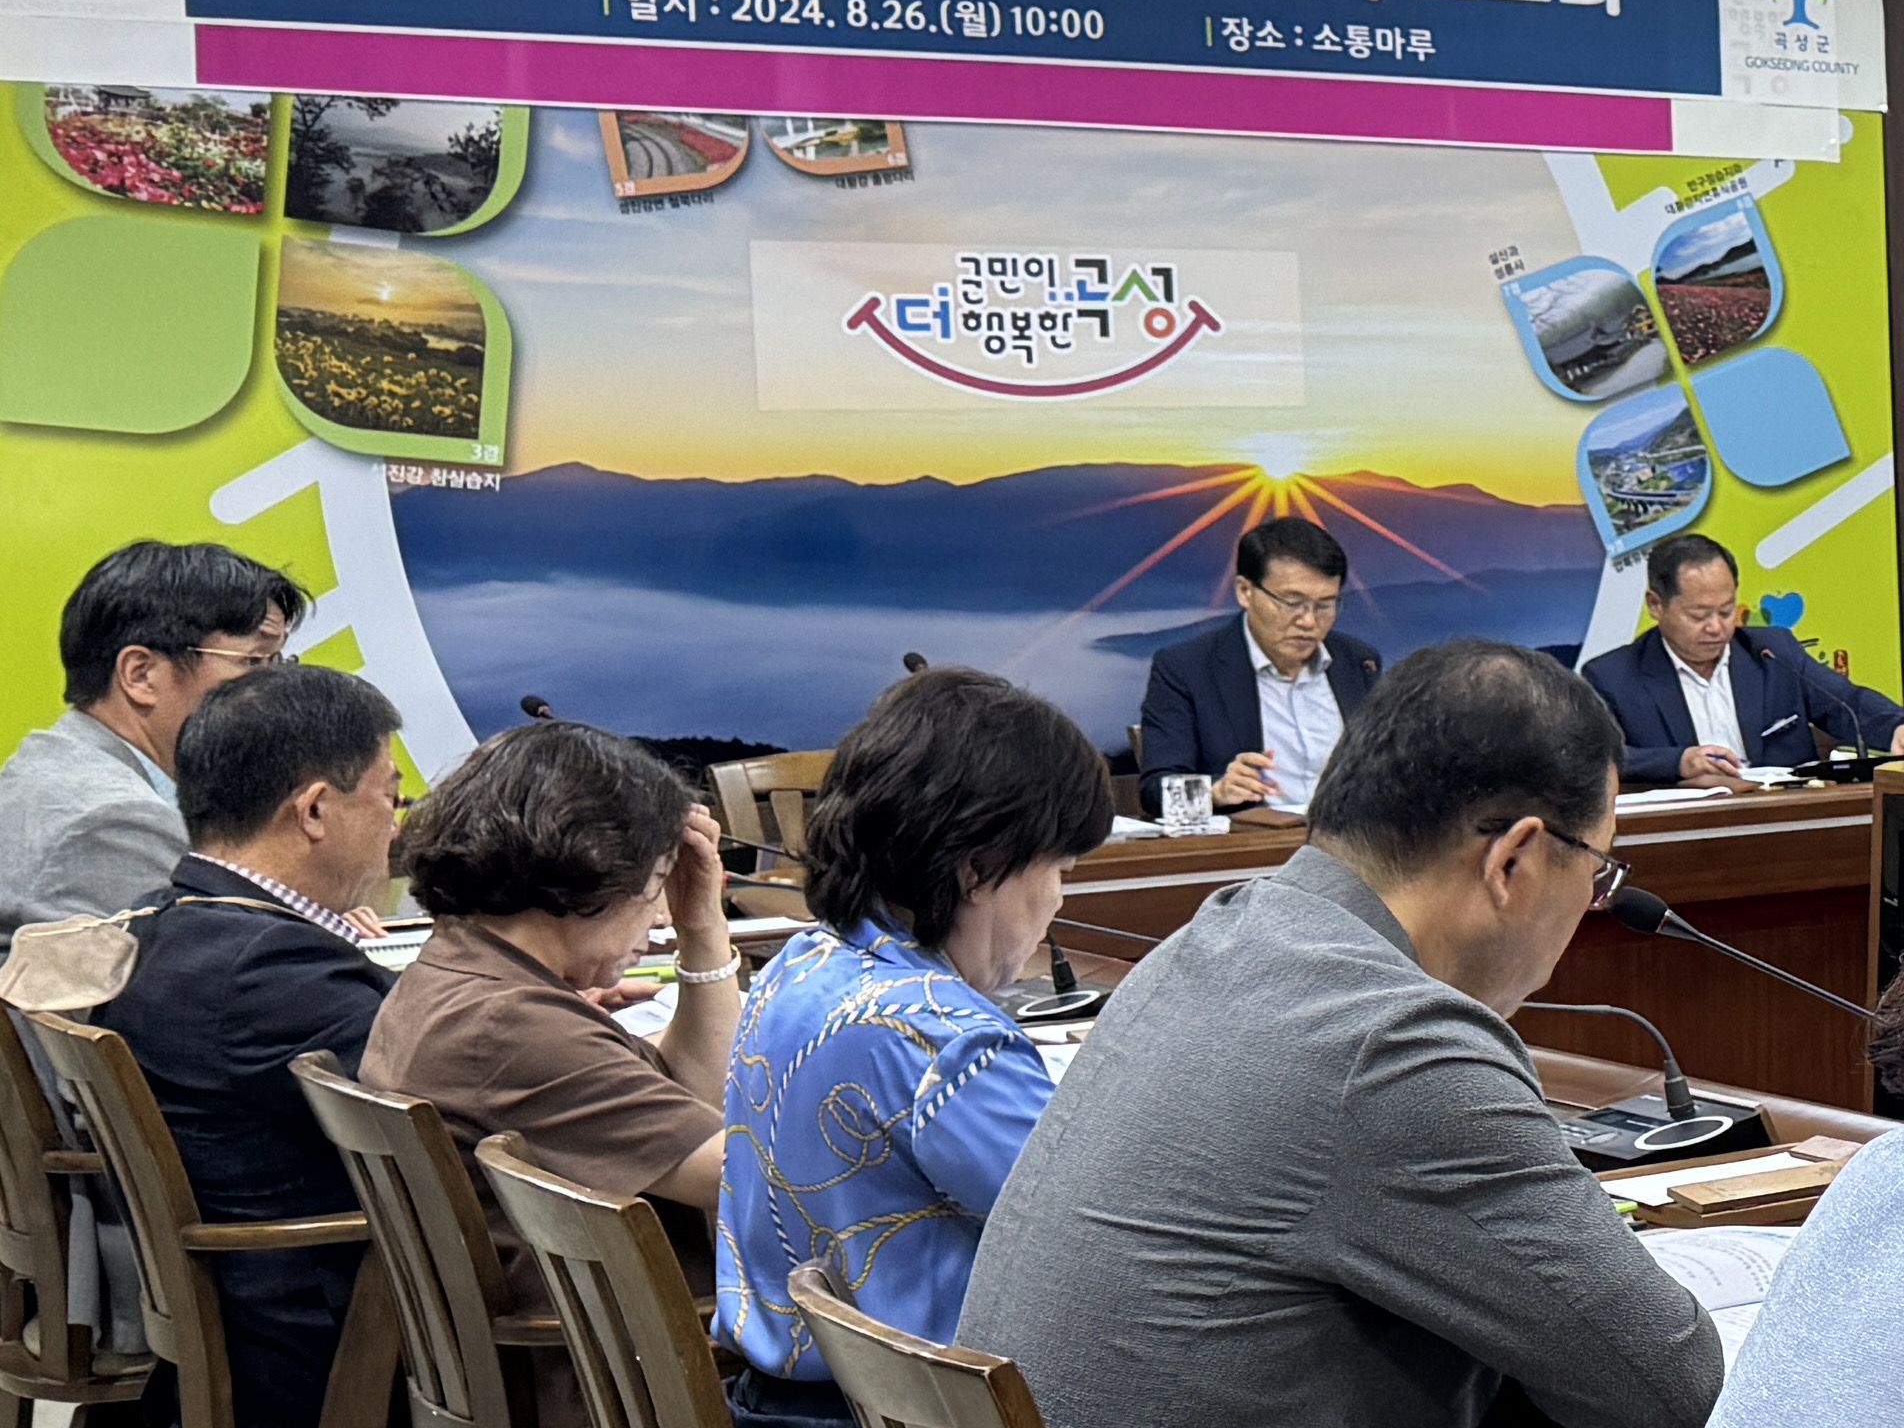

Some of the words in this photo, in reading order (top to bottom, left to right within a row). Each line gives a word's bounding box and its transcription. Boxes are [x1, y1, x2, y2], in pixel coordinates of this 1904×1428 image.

[1011, 7, 1103, 39] 10:00
[1222, 18, 1286, 51] 장소
[1313, 24, 1436, 61] 소통마루
[1745, 56, 1810, 73] GOKSEONG
[1812, 61, 1859, 75] COUNTY
[961, 257, 1054, 304] 군민이
[896, 285, 952, 339] 더
[963, 311, 1072, 364] 행복한
[1075, 259, 1176, 338] 곡성
